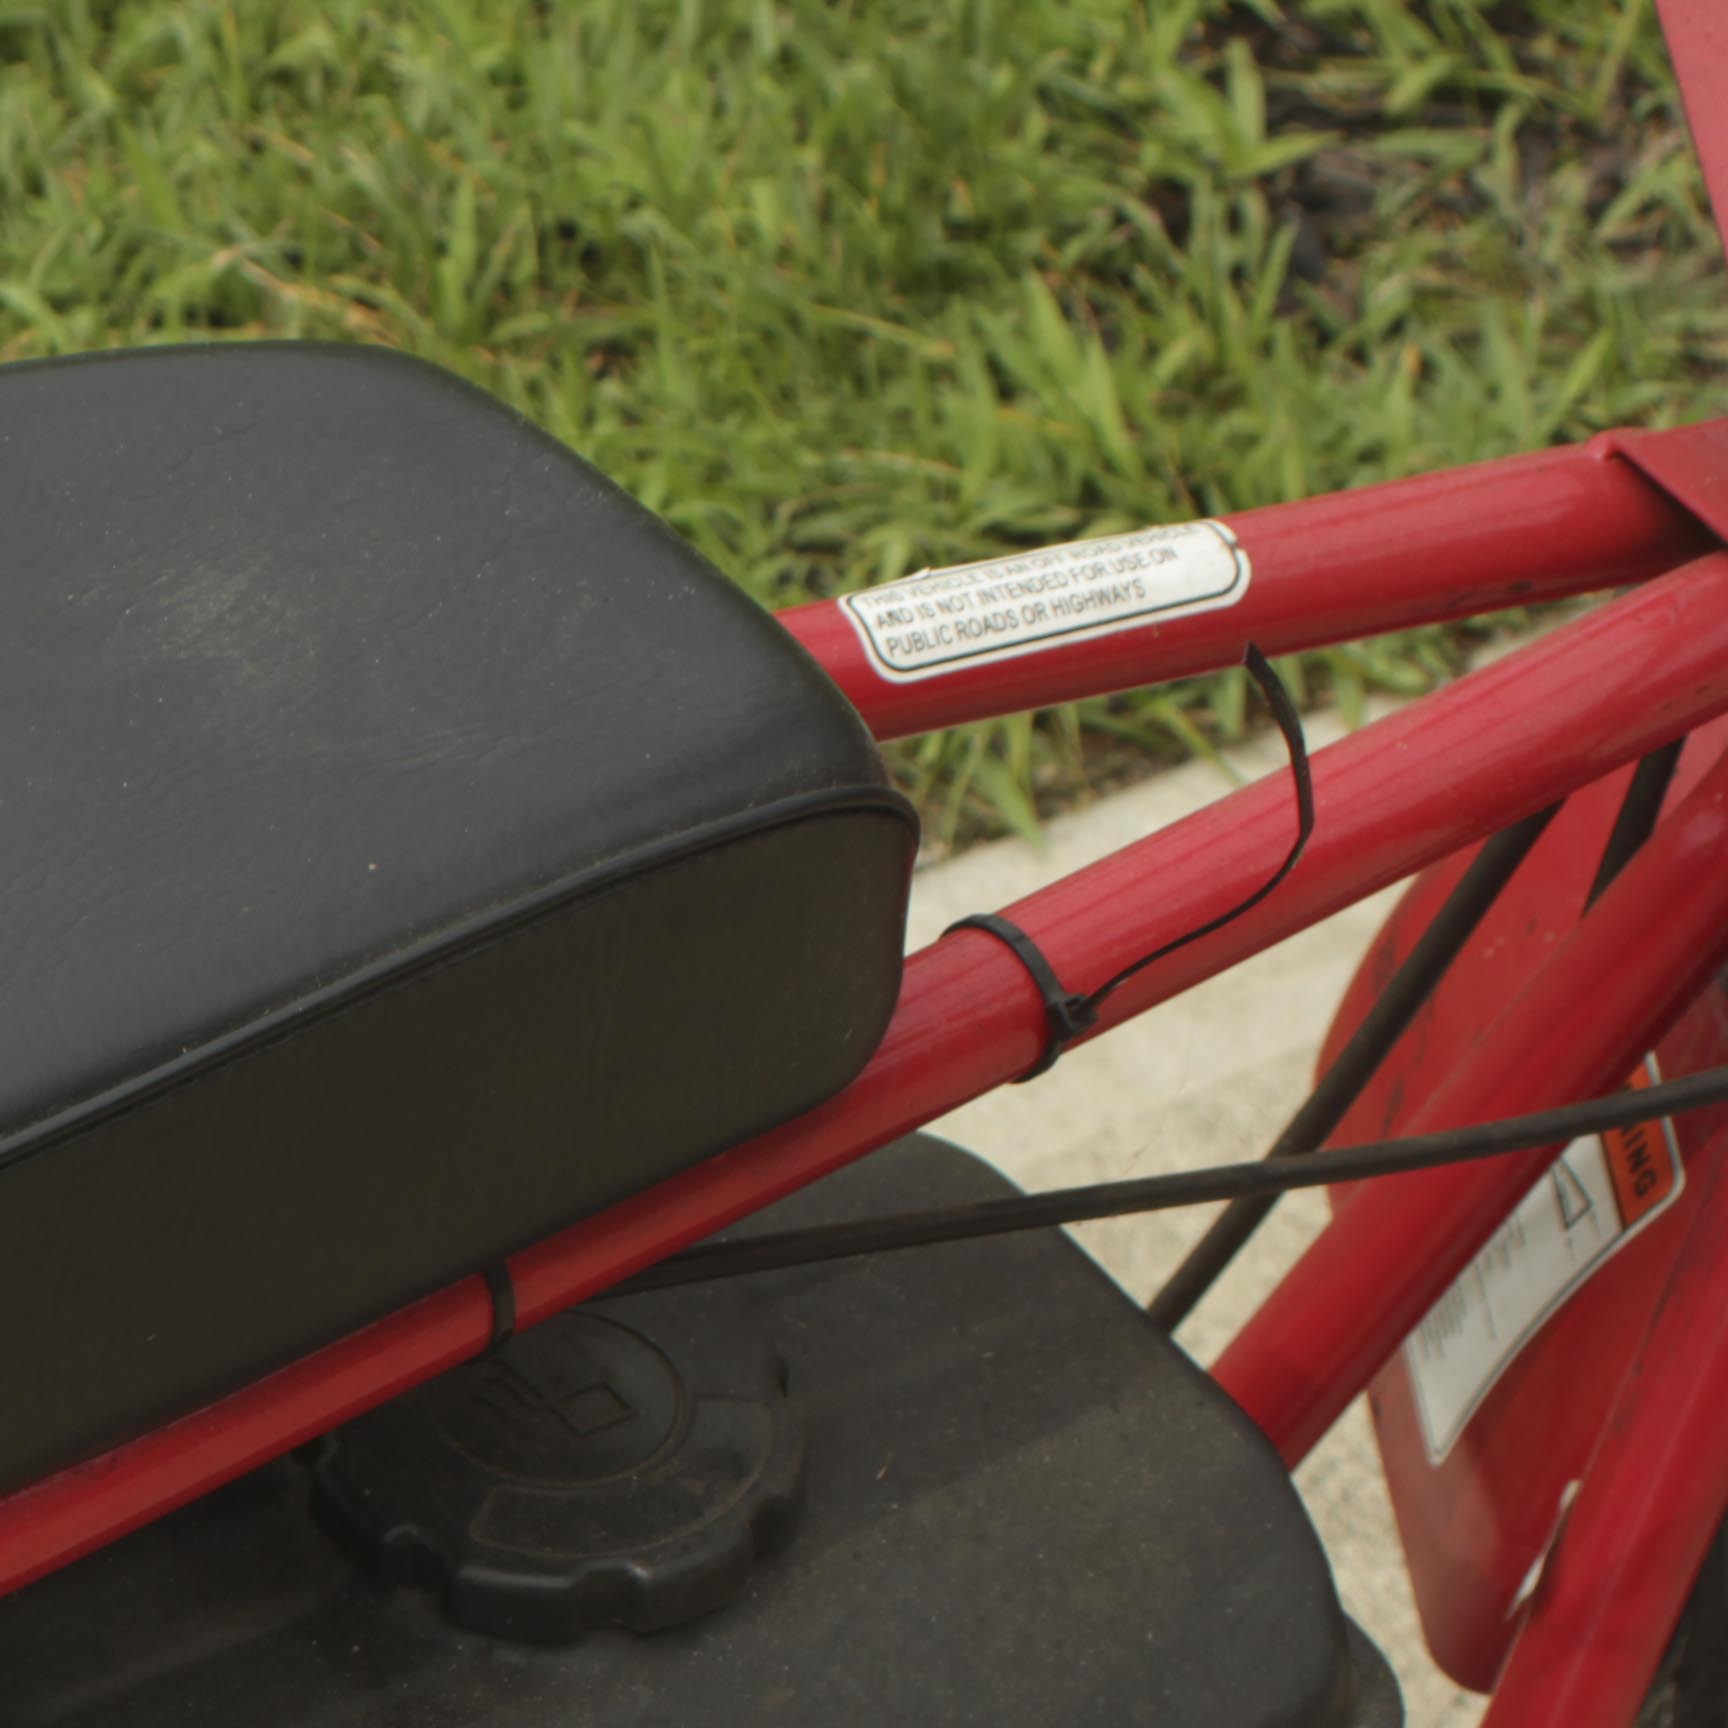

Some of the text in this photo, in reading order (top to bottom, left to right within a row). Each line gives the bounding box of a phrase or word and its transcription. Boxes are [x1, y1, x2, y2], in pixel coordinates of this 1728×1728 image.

[875, 545, 1179, 628] AND IS NOT INTENDED FOR USE ON
[885, 577, 1147, 659] PUBLIC ROADS OR HIGHWAYS
